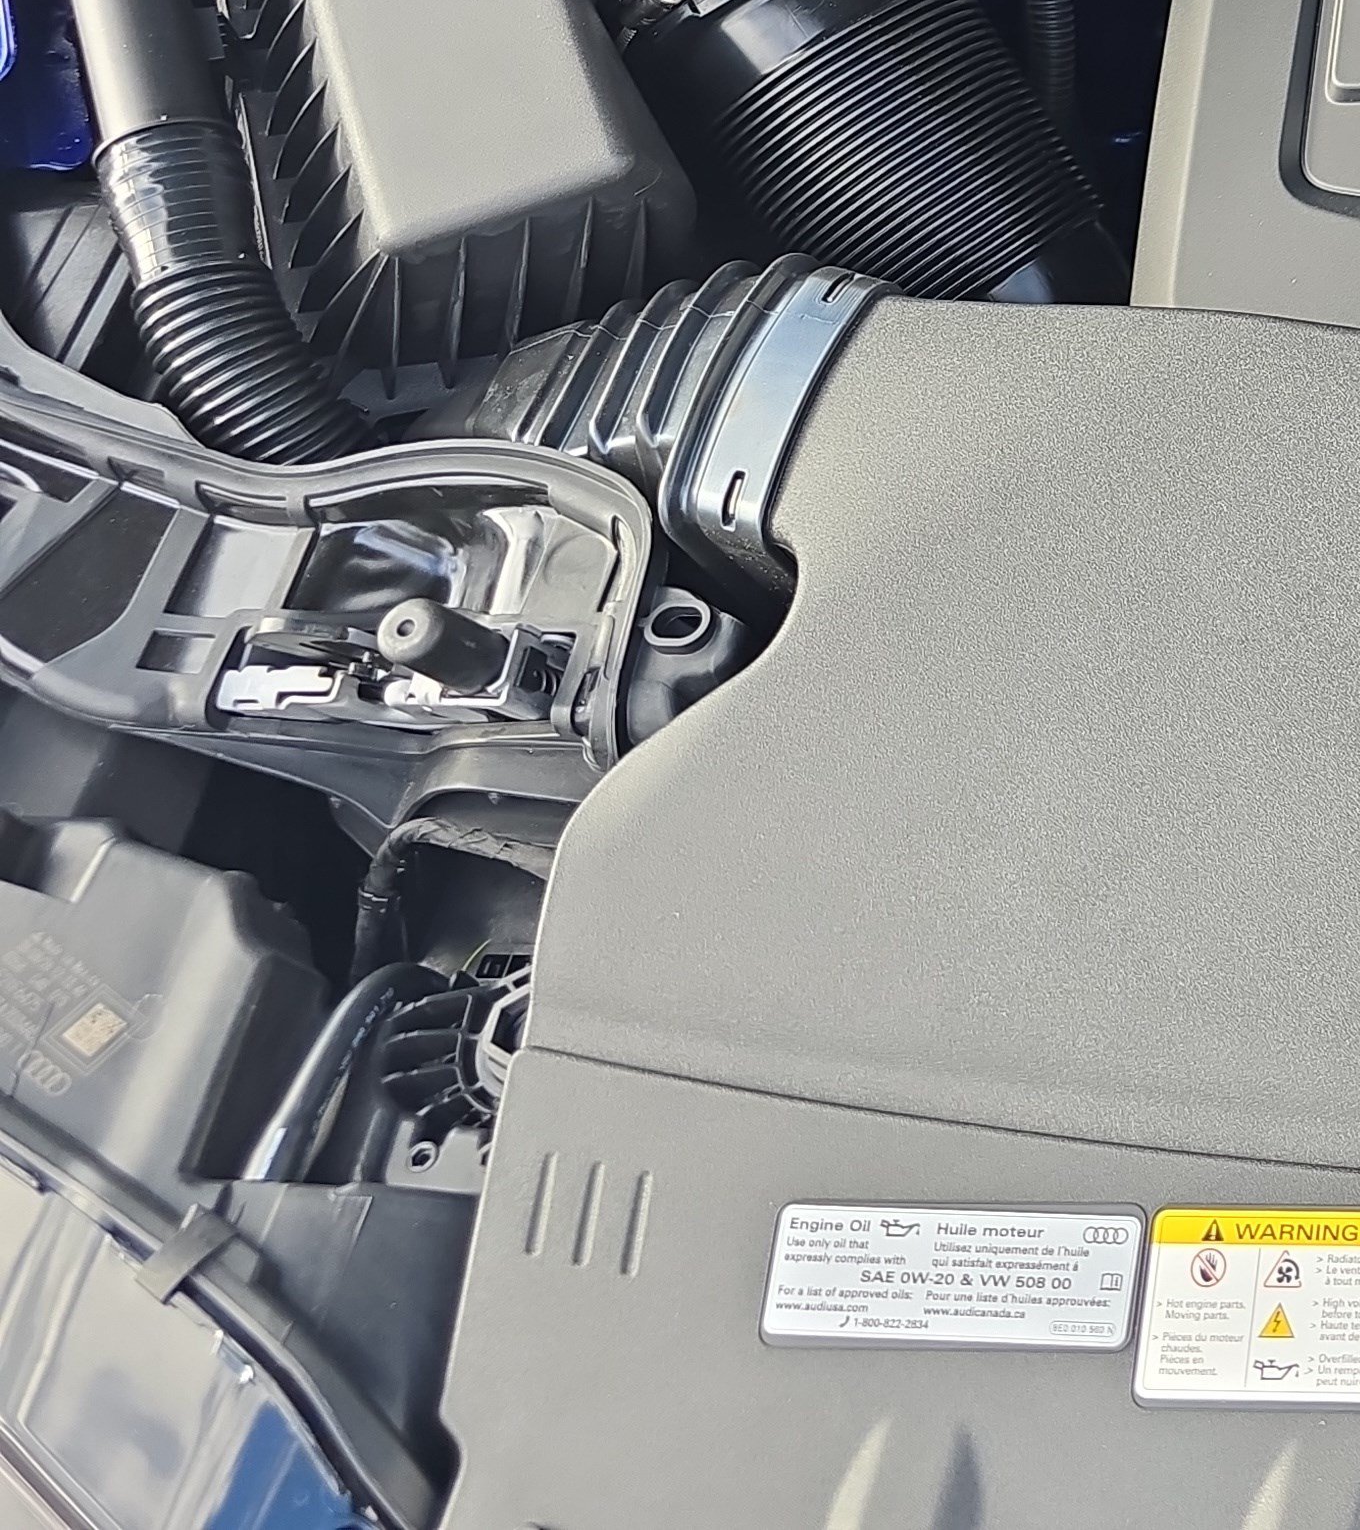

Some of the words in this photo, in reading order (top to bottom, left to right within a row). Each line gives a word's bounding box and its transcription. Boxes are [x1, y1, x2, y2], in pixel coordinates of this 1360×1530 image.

[790, 1218, 844, 1232] Engine
[850, 1220, 871, 1232] Oil
[937, 1223, 977, 1236] Huile
[982, 1226, 1044, 1238] moteur
[1236, 1223, 1359, 1241] WARNING
[787, 1236, 805, 1246] Use
[809, 1237, 830, 1249] only
[834, 1238, 846, 1248] oil
[850, 1239, 869, 1249] that
[934, 1242, 972, 1252] Utilisez
[975, 1244, 1038, 1256] uniquement
[1041, 1245, 1054, 1255] de
[784, 1251, 832, 1263] expressly
[834, 1254, 881, 1265] complies
[884, 1256, 906, 1265] with
[932, 1257, 949, 1268] qui
[952, 1258, 992, 1268] satisfait
[1326, 1266, 1337, 1274] Le
[860, 1270, 895, 1283] SAE
[900, 1272, 955, 1286] 0W-20
[960, 1274, 973, 1286] &
[980, 1274, 1011, 1287] VW
[1016, 1276, 1045, 1288] 508
[1052, 1278, 1072, 1289] 00
[778, 1285, 795, 1294] For
[807, 1285, 822, 1296] list
[825, 1286, 836, 1297] of
[839, 1288, 888, 1299] approved
[926, 1290, 950, 1300] Pour
[954, 1293, 972, 1302] une
[976, 1292, 997, 1302] liste
[776, 1301, 868, 1312] www.audiusa.com
[1166, 1299, 1183, 1308] Hot
[1186, 1301, 1216, 1310] engine
[1323, 1298, 1345, 1308] High
[924, 1307, 1025, 1318] www.audicanada.ca
[1165, 1310, 1201, 1320] Moving
[1321, 1310, 1351, 1319] before
[854, 1318, 929, 1328] 1-800-822-2834
[1321, 1322, 1348, 1330] Haute
[1195, 1333, 1206, 1342] du
[1320, 1333, 1346, 1341] avant
[1348, 1333, 1360, 1341] de
[1318, 1366, 1331, 1374] Un
[1316, 1378, 1338, 1386] peut
